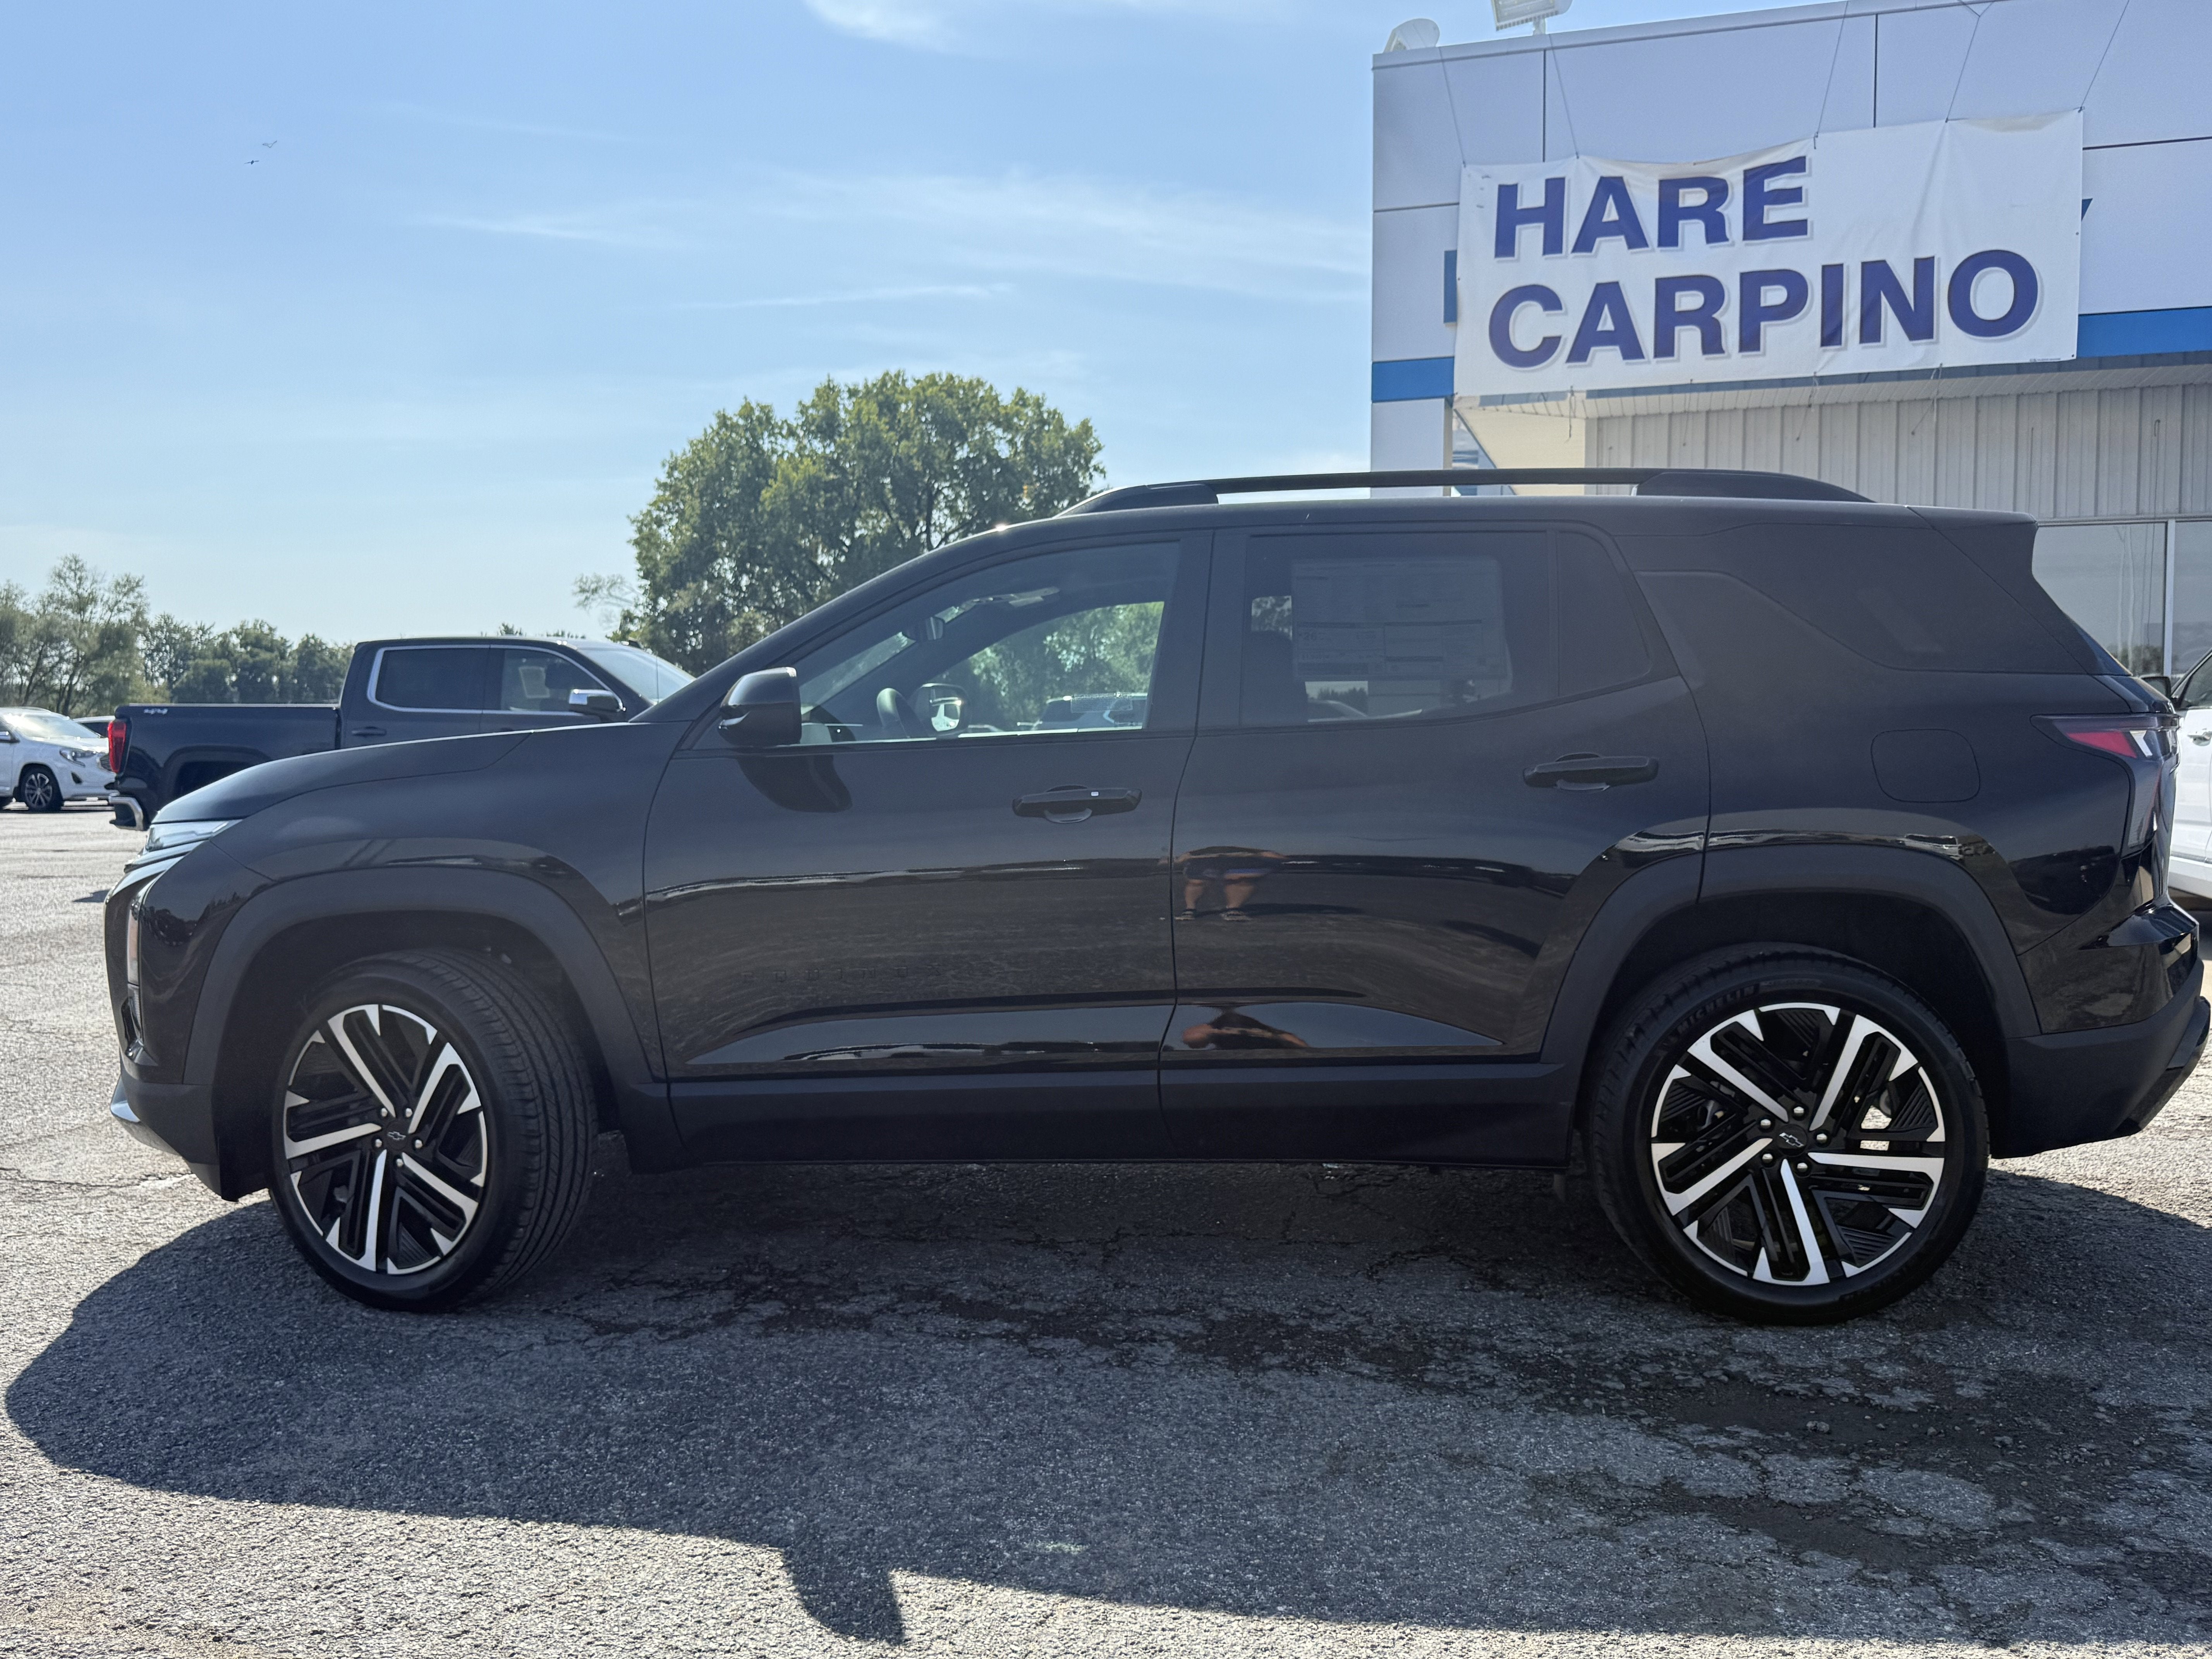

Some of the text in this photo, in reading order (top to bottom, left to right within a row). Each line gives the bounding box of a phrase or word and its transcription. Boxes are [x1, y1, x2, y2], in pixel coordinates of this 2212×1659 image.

[1494, 155, 1809, 259] HARE
[1488, 249, 2039, 368] CARPINO
[1676, 984, 1756, 1035] MICHELIN
